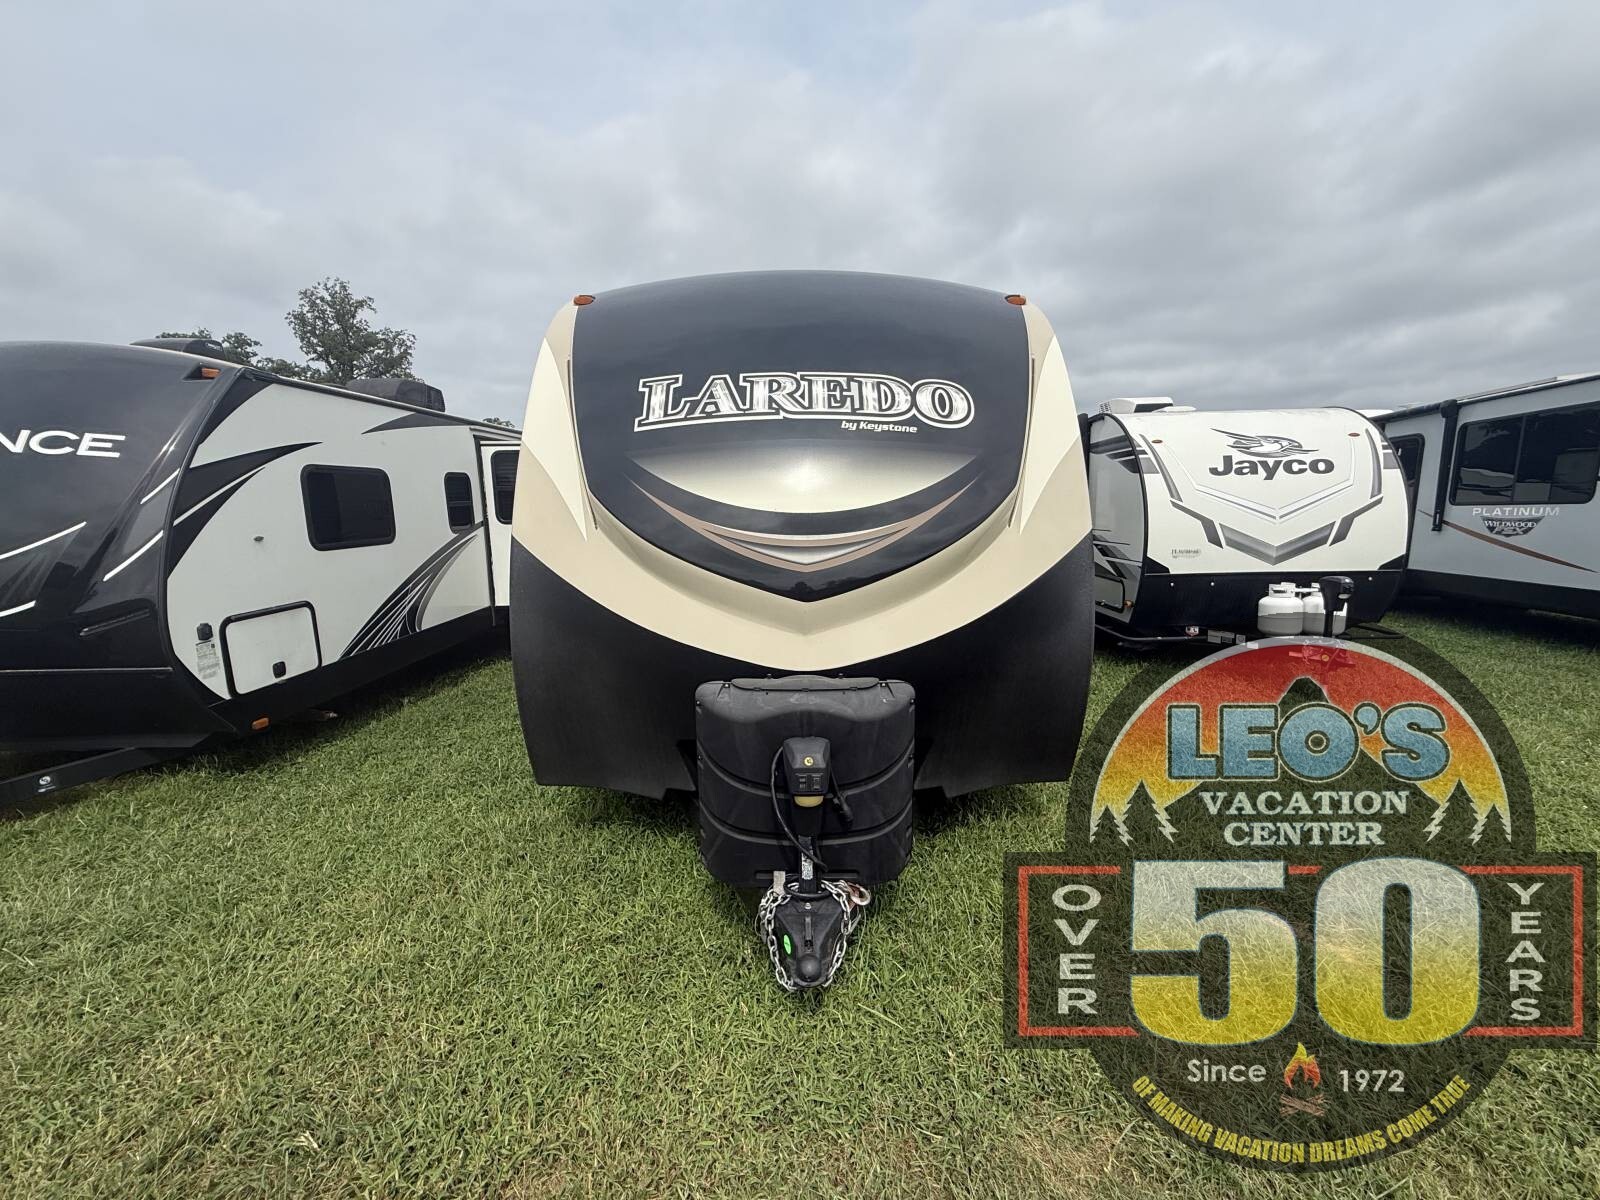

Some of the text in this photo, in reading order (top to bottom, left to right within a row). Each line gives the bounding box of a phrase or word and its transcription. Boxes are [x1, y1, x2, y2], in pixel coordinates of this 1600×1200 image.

[634, 372, 974, 432] LAREDO
[841, 421, 918, 433] by Keystone
[1208, 455, 1335, 480] Jayco
[1472, 507, 1560, 516] PLATINUM
[1484, 520, 1537, 528] WILDWOOD
